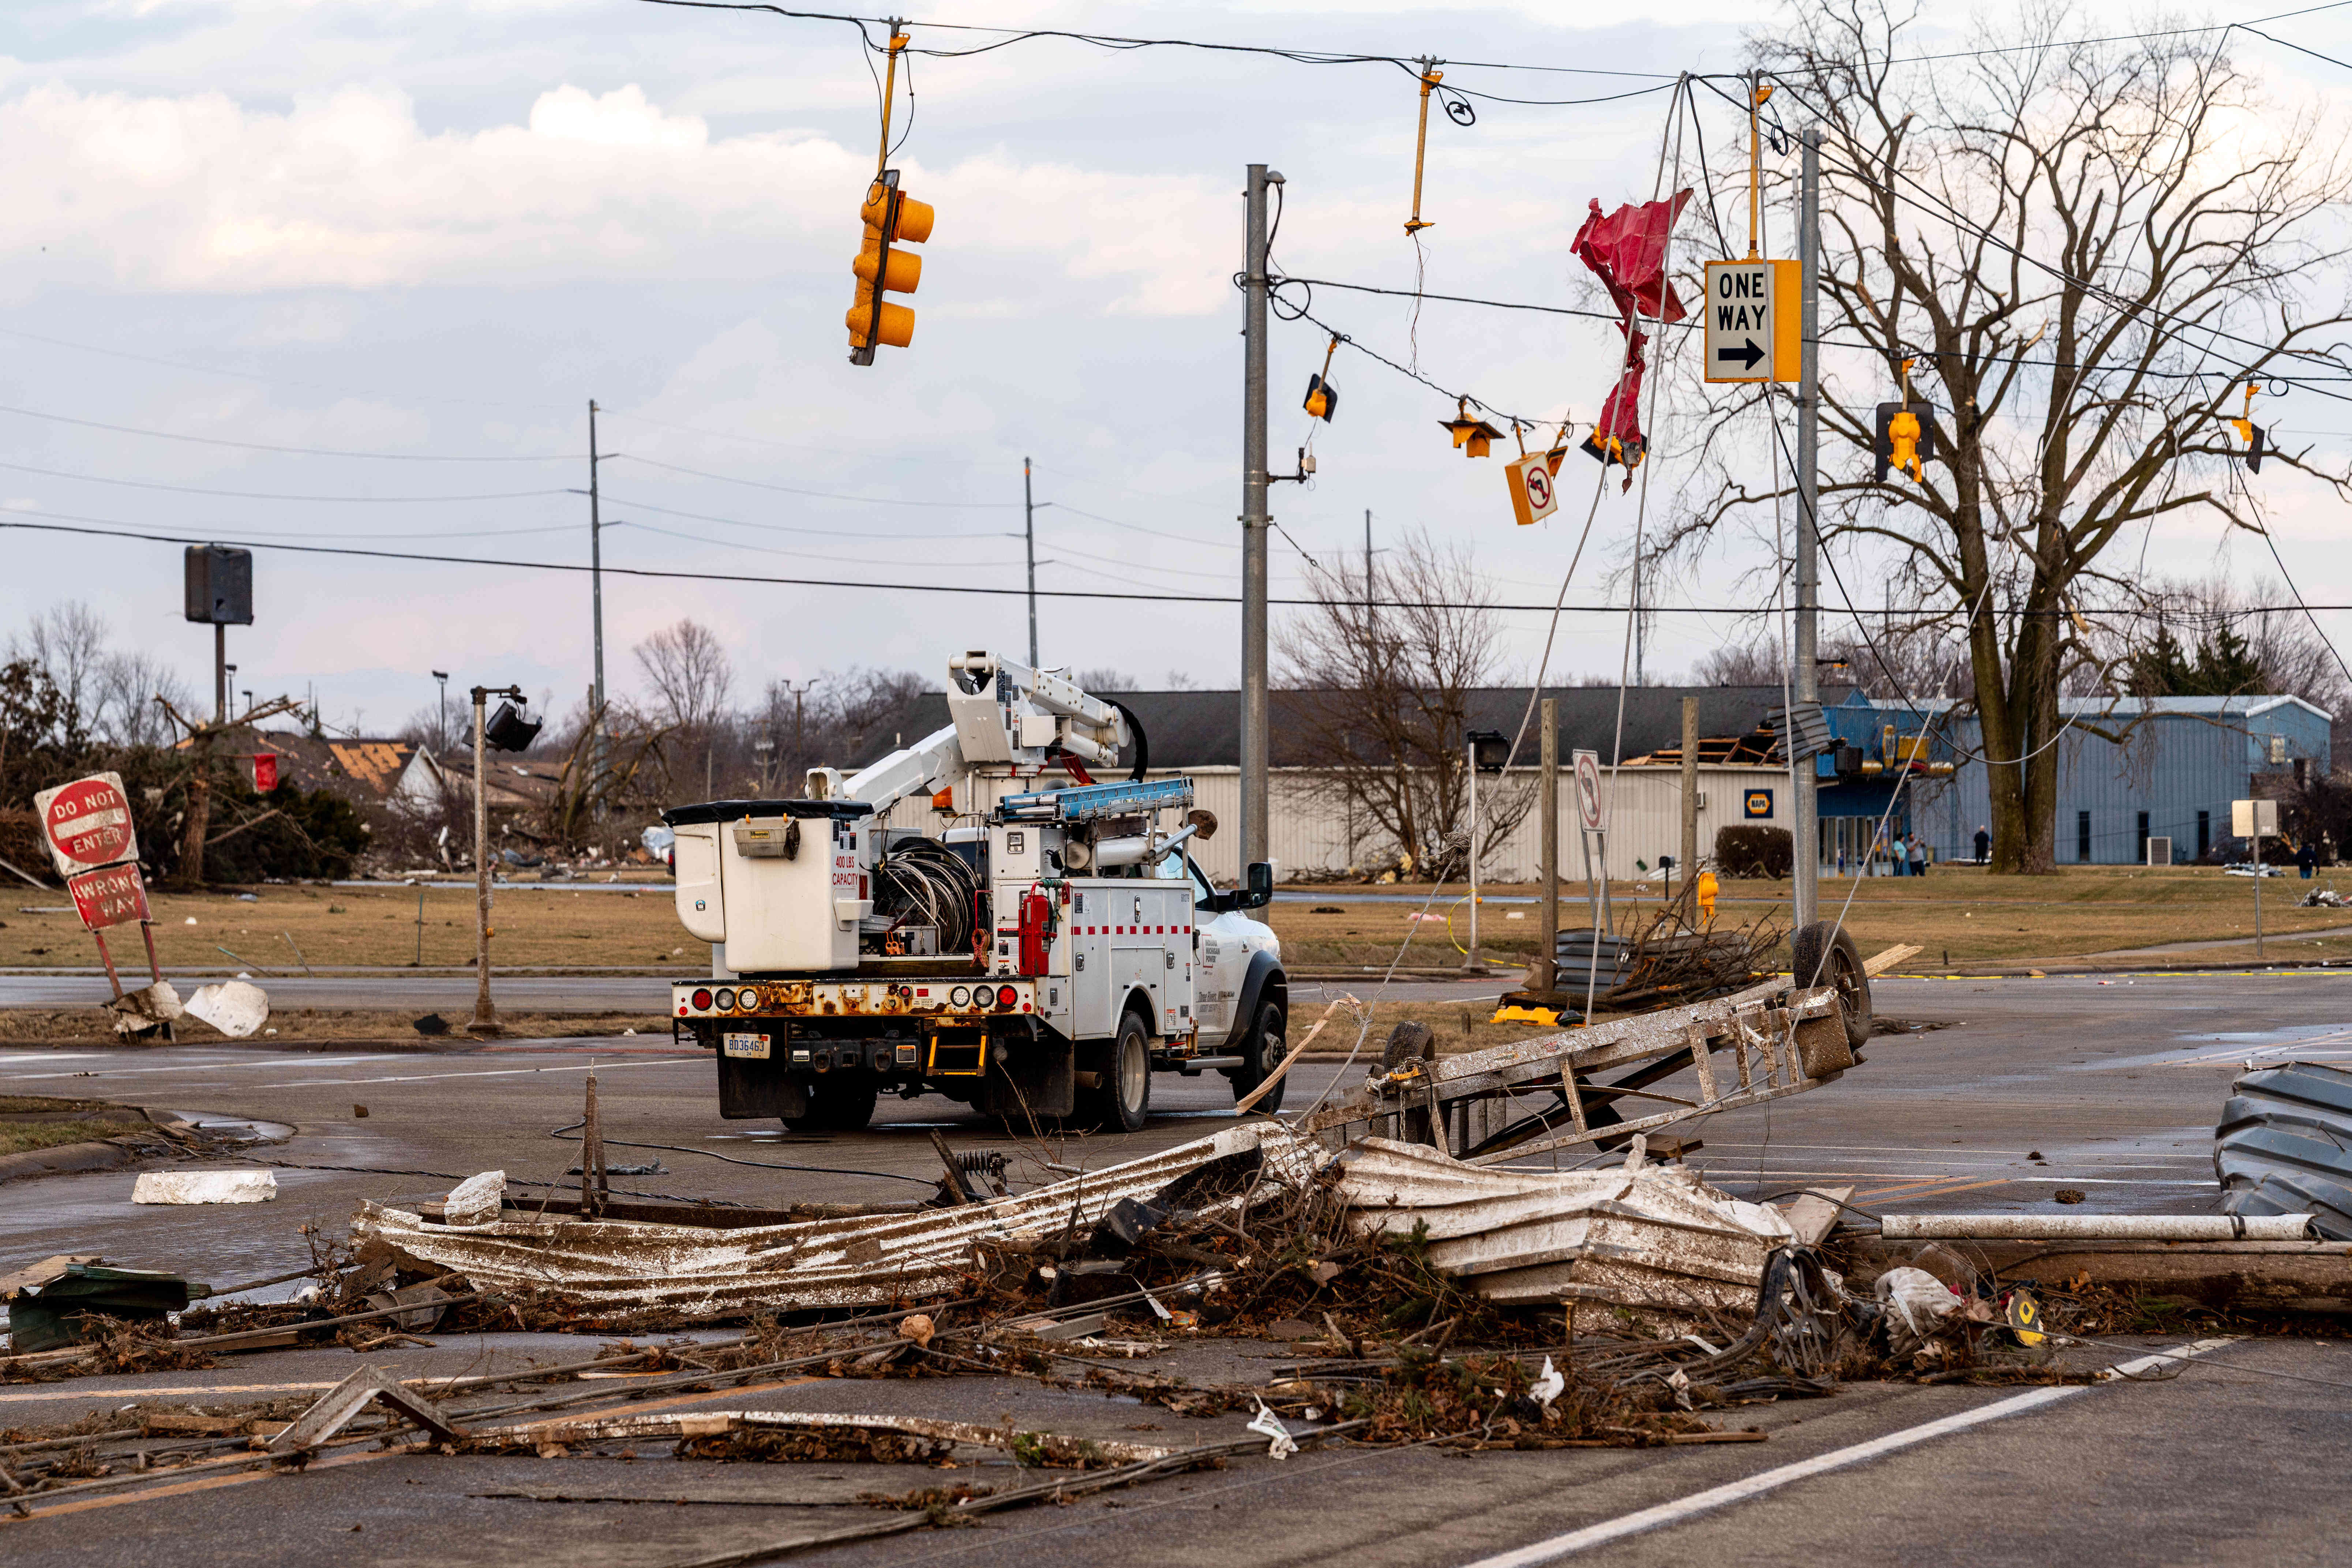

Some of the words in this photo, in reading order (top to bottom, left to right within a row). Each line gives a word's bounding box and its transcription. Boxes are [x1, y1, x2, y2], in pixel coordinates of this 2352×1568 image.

[1719, 273, 1764, 299] ONE
[1718, 304, 1766, 331] WAY
[54, 801, 77, 819] DO
[84, 790, 116, 810] NOT
[1751, 800, 1766, 808] NAPA
[72, 831, 123, 854] ENTER
[836, 856, 845, 868] 400
[846, 856, 854, 868] LBS
[79, 873, 140, 900] WRONG
[832, 873, 858, 885] CAPACITY
[101, 896, 136, 917] WAY
[1198, 991, 1207, 1002] Three
[729, 1039, 764, 1052] BD36463
